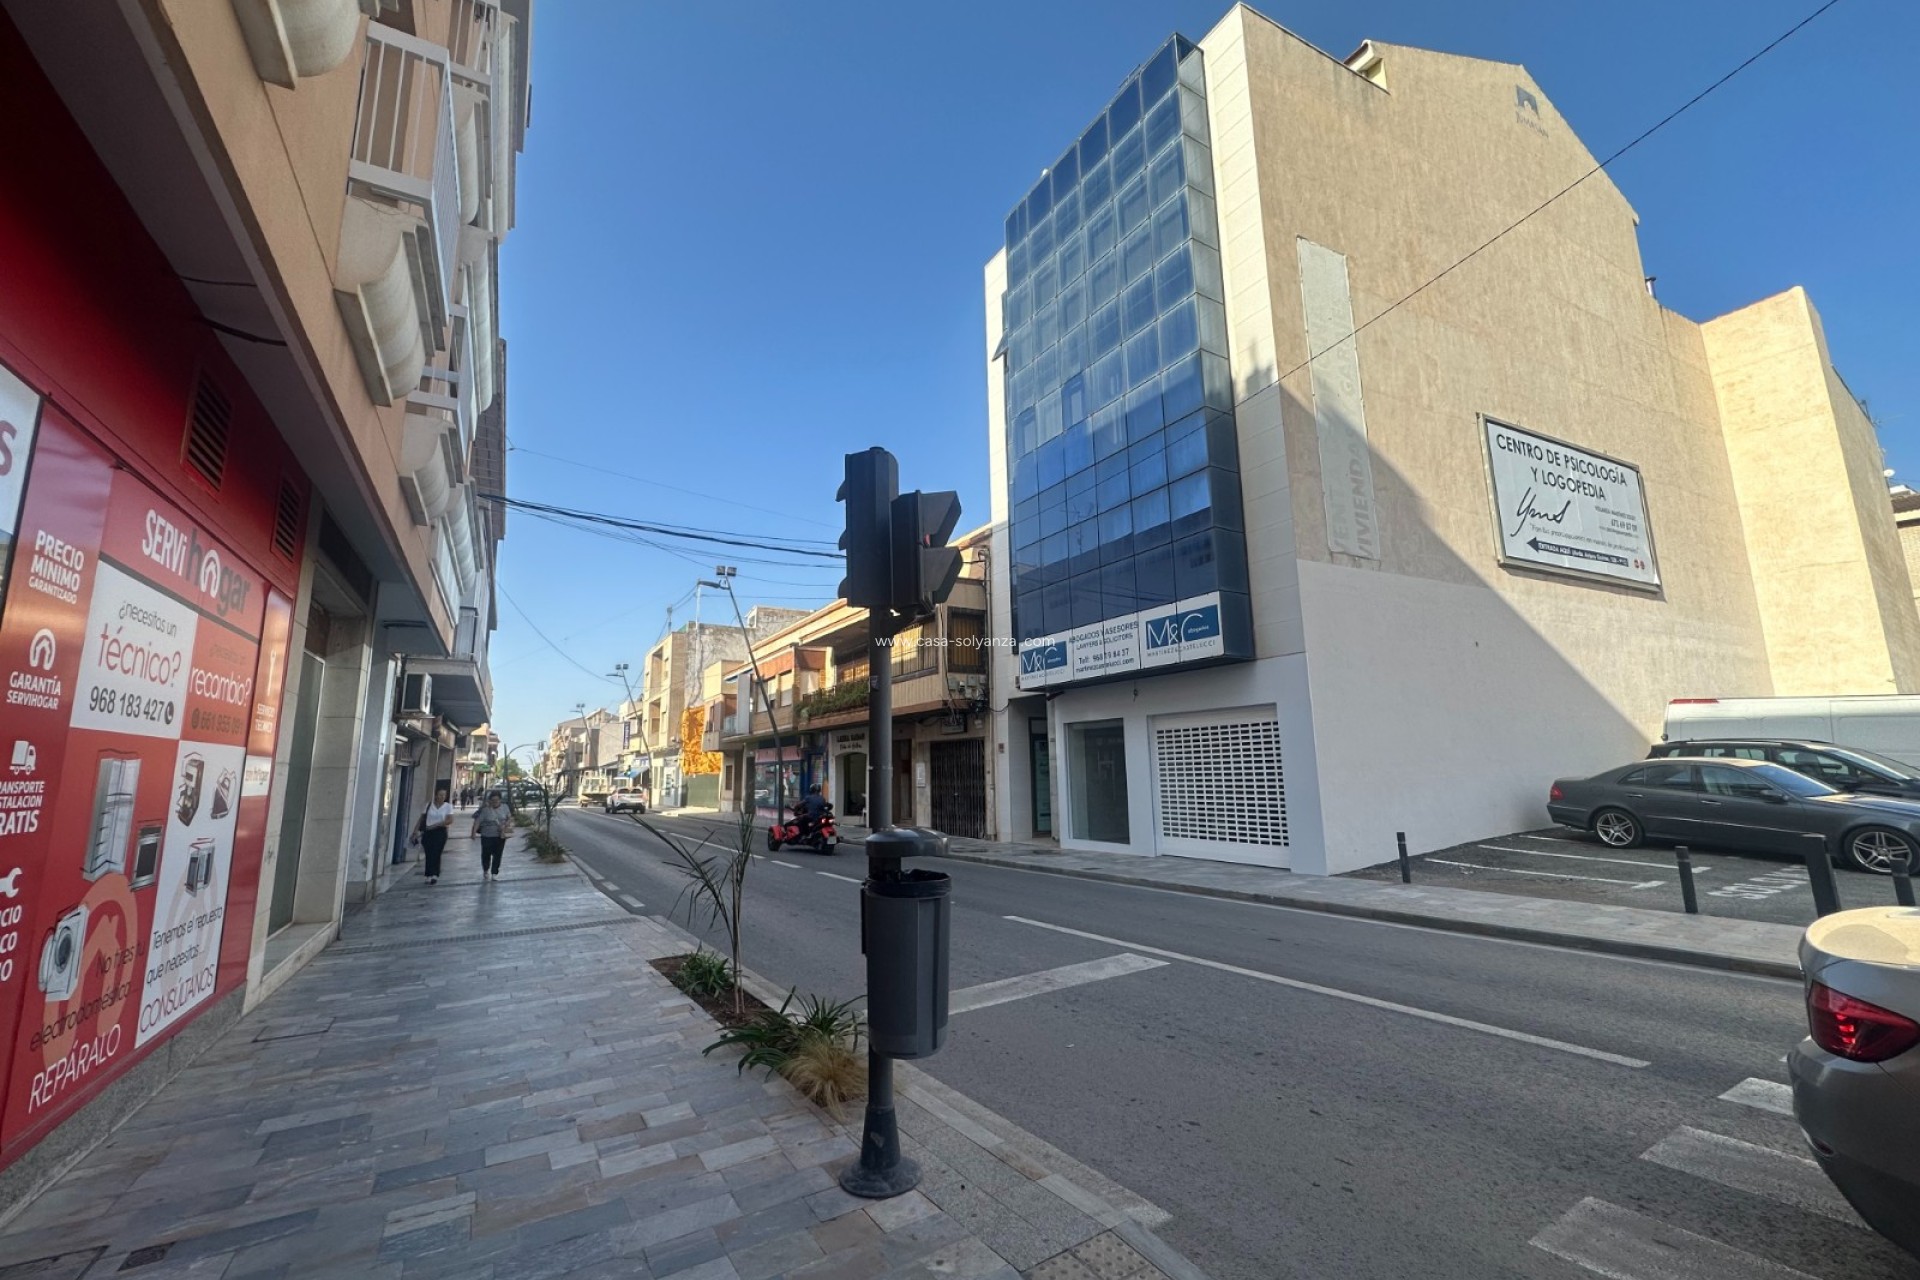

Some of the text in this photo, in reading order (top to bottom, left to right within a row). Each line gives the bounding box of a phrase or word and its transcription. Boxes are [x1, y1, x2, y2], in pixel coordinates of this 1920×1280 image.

[1496, 434, 1628, 487] CENTRO DE PSICOLOGÍA
[1530, 466, 1606, 500] Y LOGOPEDIA
[35, 529, 85, 571] PRECIO
[28, 575, 78, 605] GARANTIZADO
[1105, 620, 1139, 635] ASESORES
[98, 623, 182, 688] técnico?
[6, 690, 59, 710] SERVIHOGAR
[9, 671, 62, 696] GARANTÍA
[189, 667, 252, 707] recambio?
[89, 686, 165, 722] 968 183 427
[0, 781, 45, 794] ANSPORTE
[153, 922, 187, 949] Tenemos
[196, 907, 223, 929] repuesto
[96, 955, 112, 978] No
[146, 963, 164, 987] que
[140, 964, 215, 1033] CONSÚLTANOS
[28, 1024, 121, 1114] REPÁRALO
